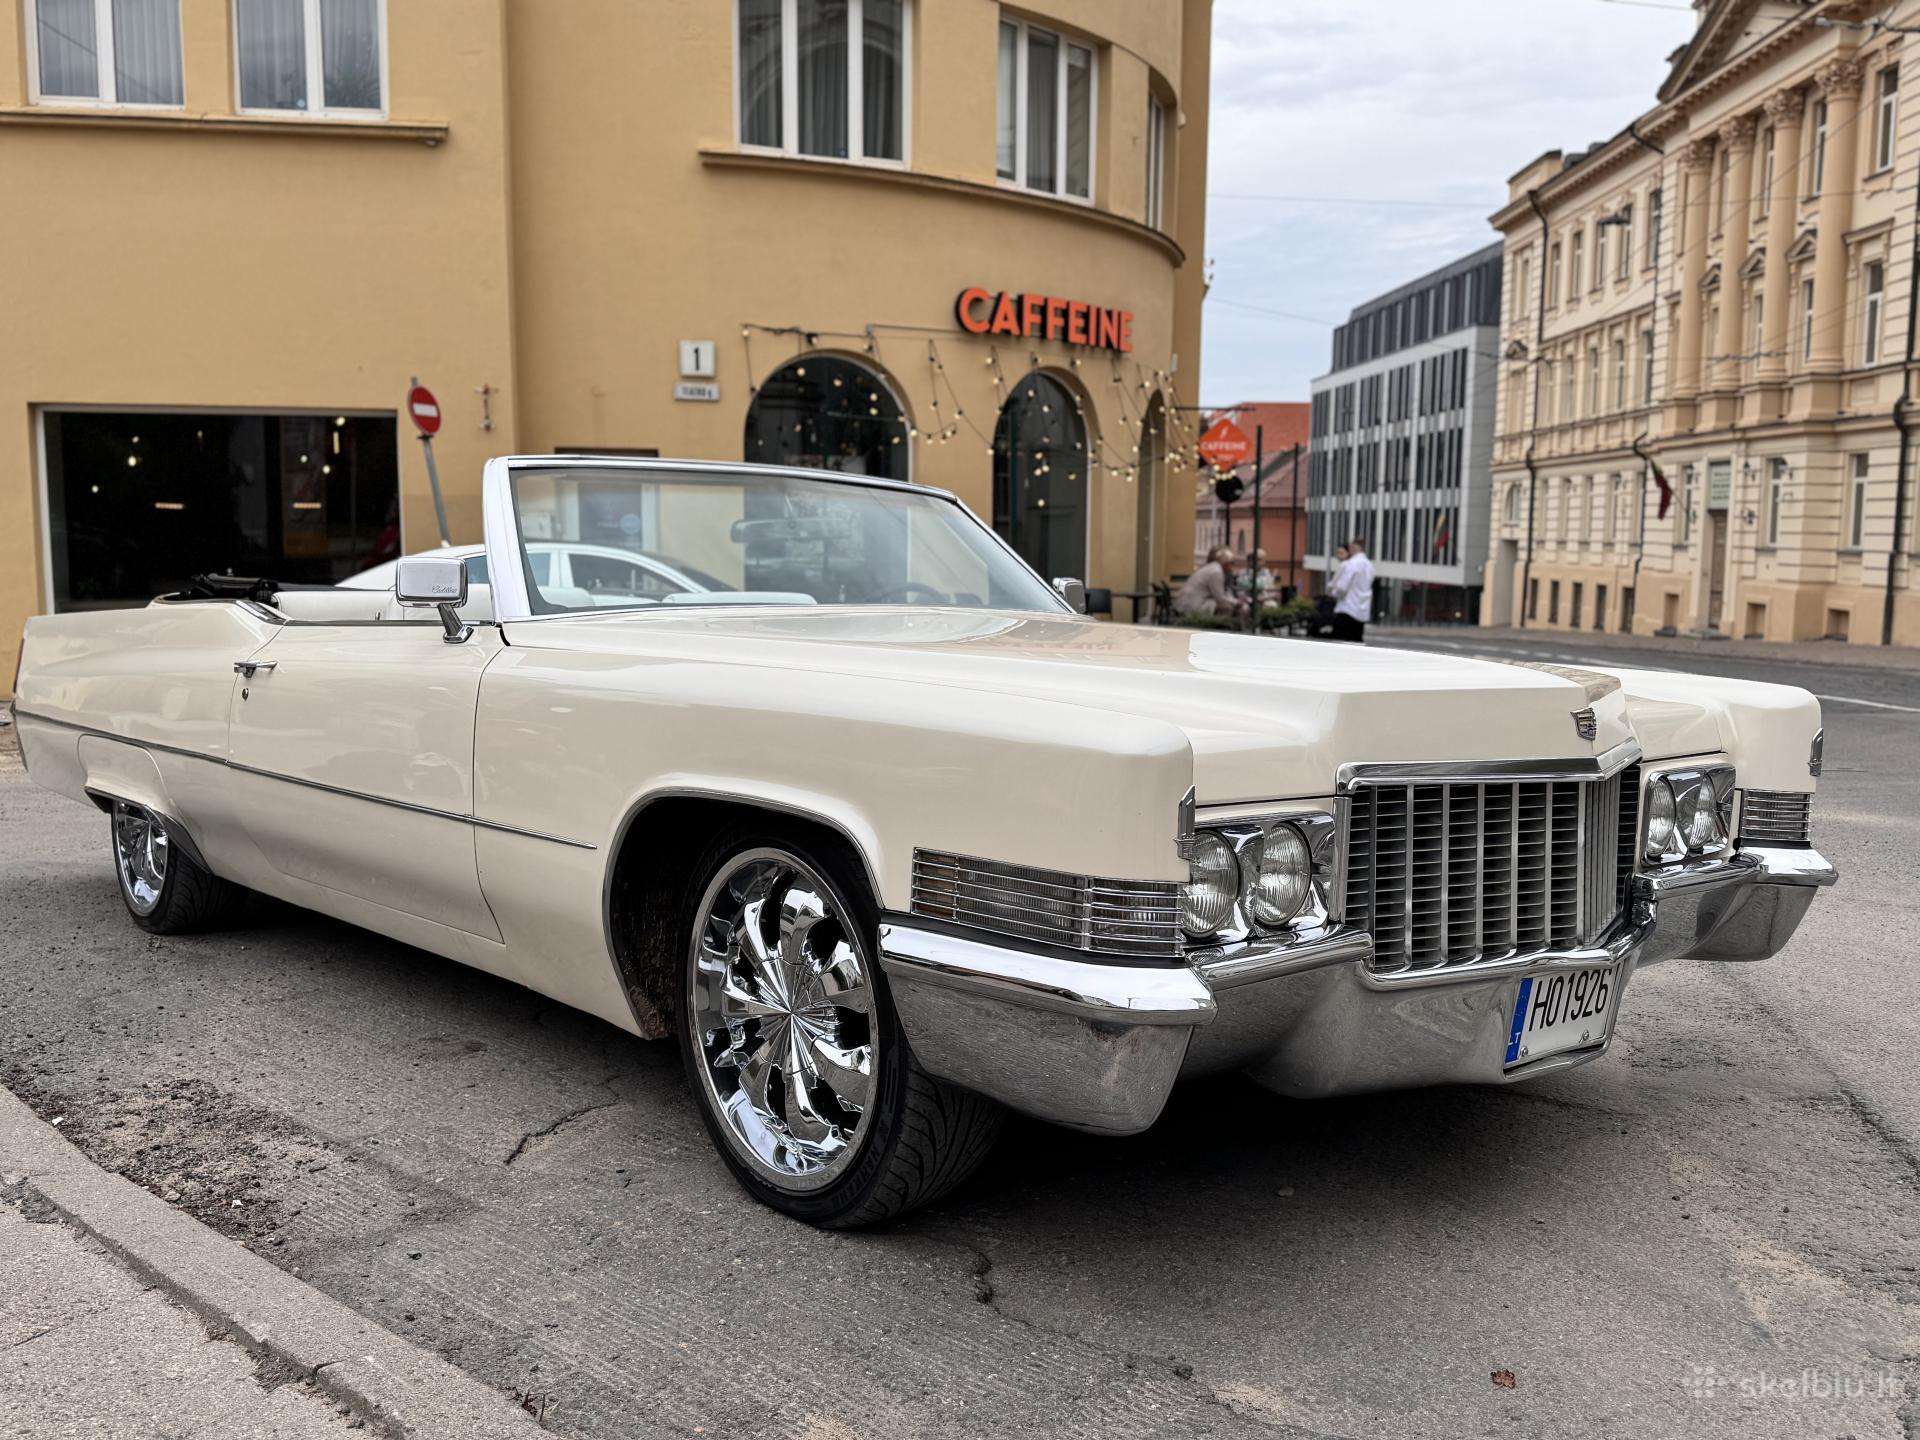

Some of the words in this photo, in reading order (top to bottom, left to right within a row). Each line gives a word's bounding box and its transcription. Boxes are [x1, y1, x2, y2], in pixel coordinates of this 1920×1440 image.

[956, 287, 1134, 352] CAFFEINE
[694, 346, 700, 371] 1
[1528, 968, 1613, 1032] H01926
[1507, 1031, 1522, 1046] LT
